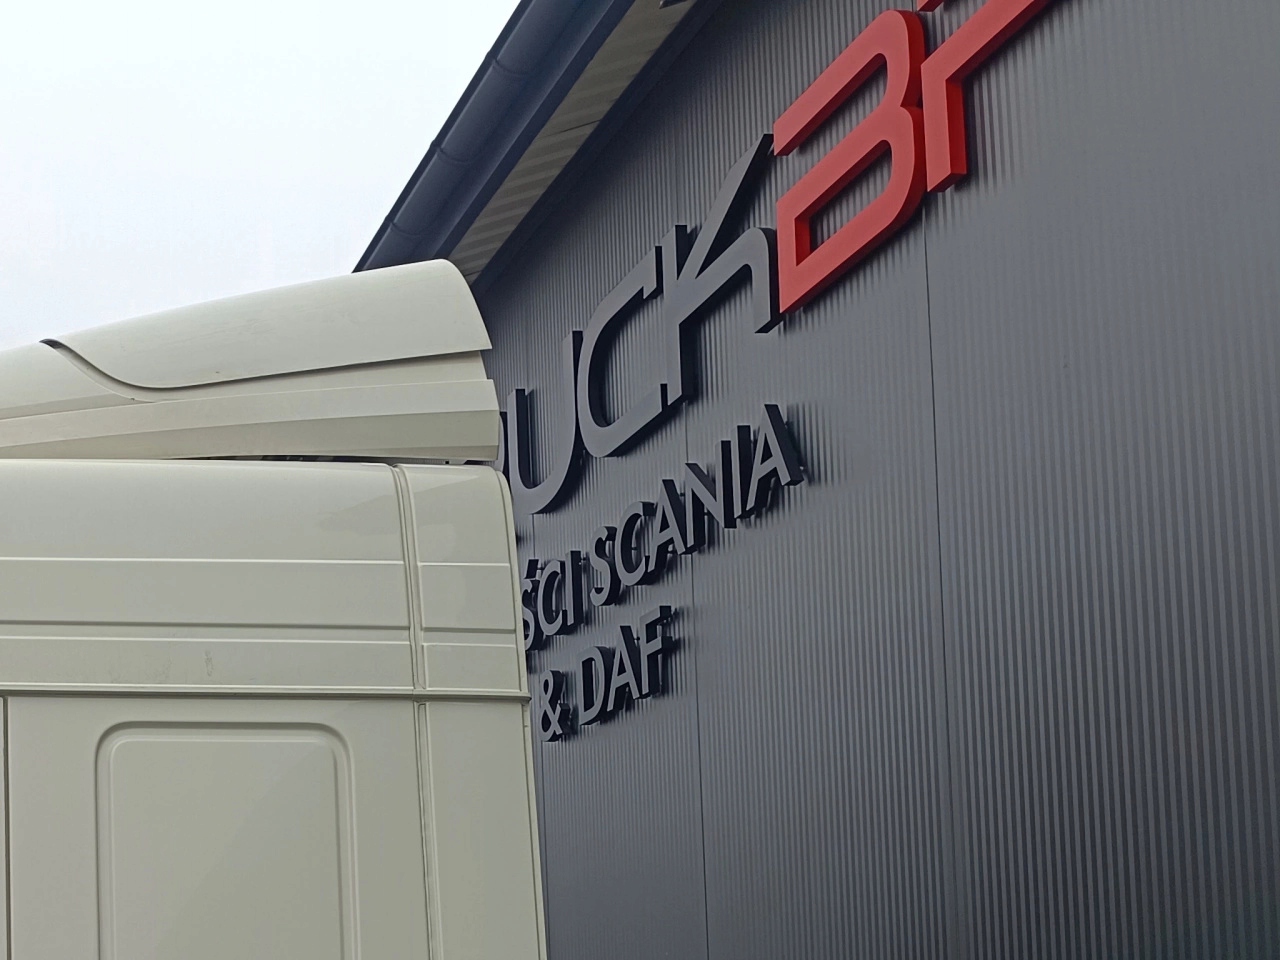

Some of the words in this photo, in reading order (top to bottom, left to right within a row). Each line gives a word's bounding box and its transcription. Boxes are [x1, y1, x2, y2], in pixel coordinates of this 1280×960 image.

[589, 403, 803, 606] SCANIA
[538, 669, 570, 742] &
[578, 605, 672, 726] DAF
